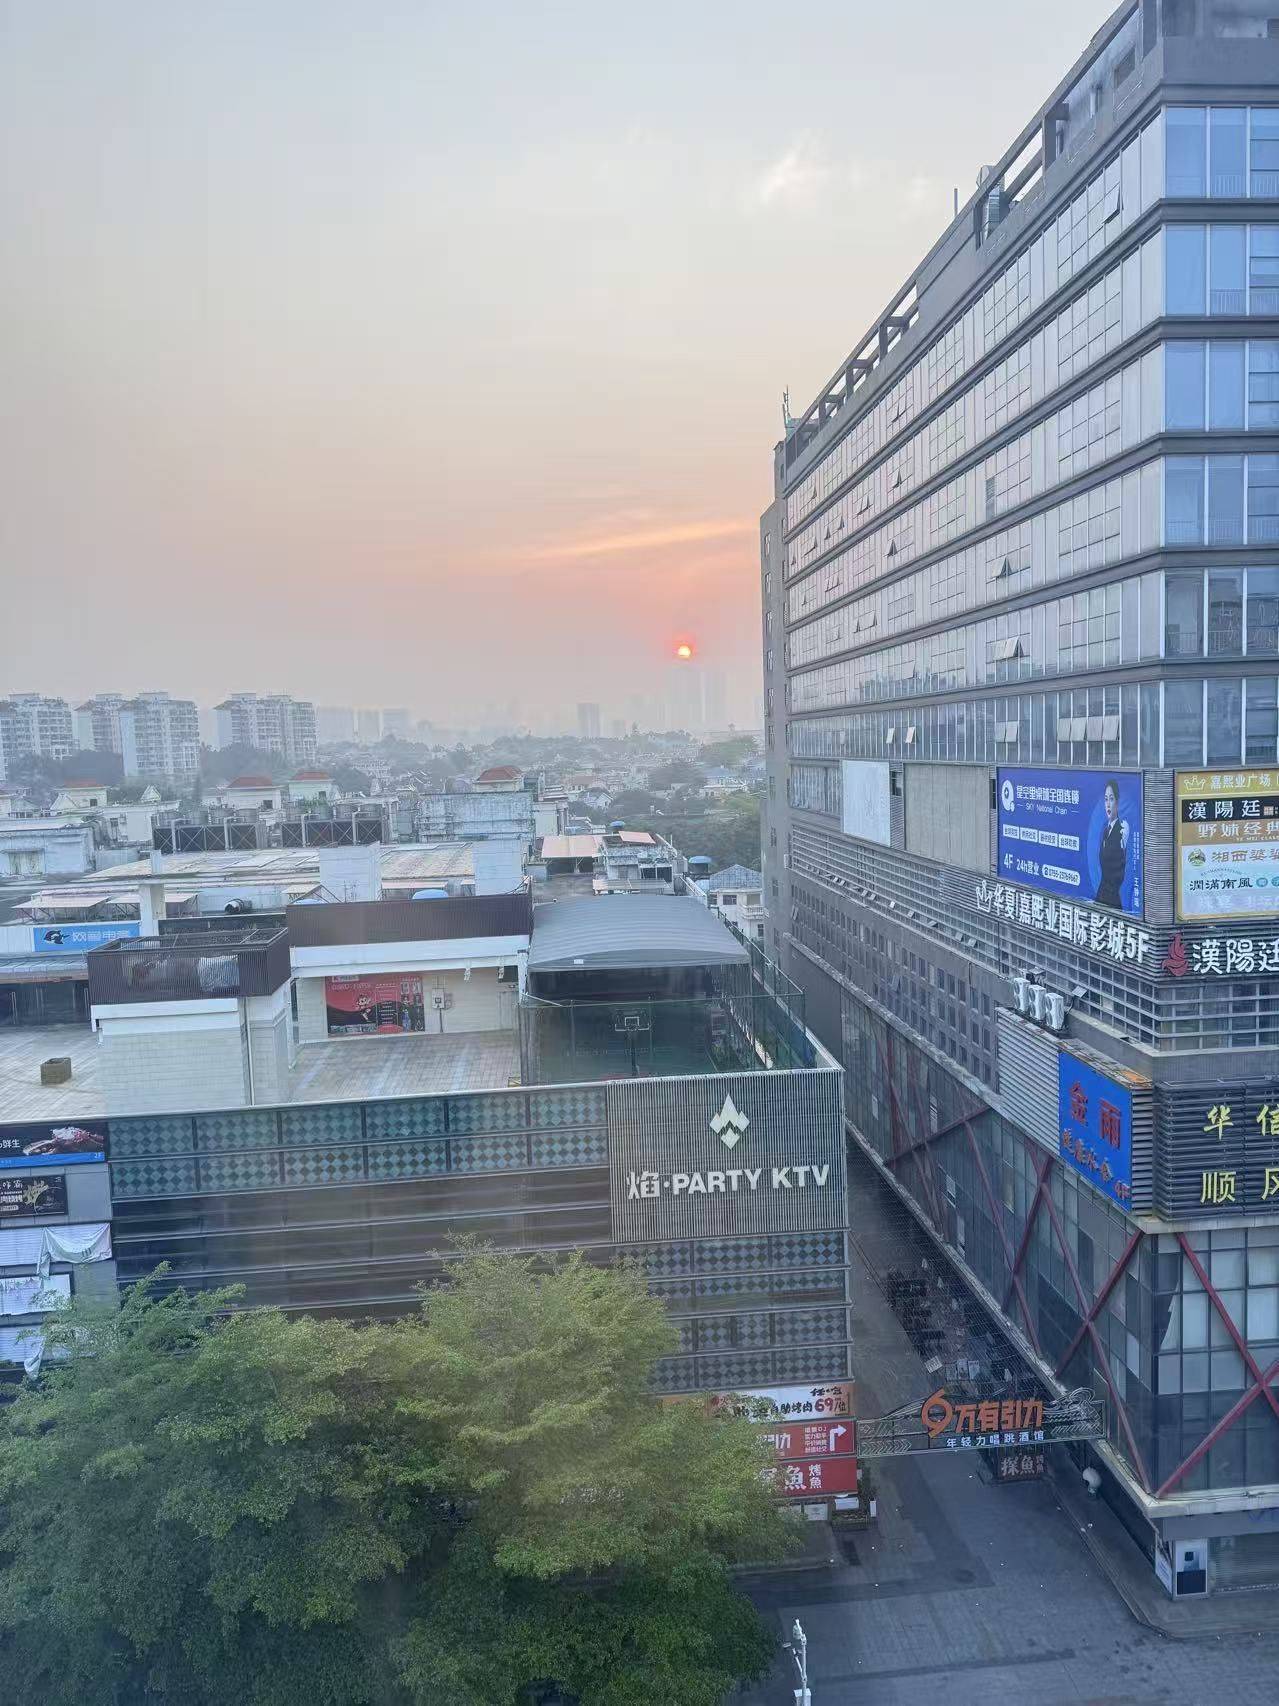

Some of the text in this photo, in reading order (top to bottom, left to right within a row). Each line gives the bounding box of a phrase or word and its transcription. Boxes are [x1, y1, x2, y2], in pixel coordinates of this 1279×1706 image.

[1003, 853, 1014, 869] 4F
[1203, 1104, 1279, 1141] 华信
[772, 1164, 830, 1189] KTV
[946, 1431, 1045, 1448] 年轻力唱跳酒馆
